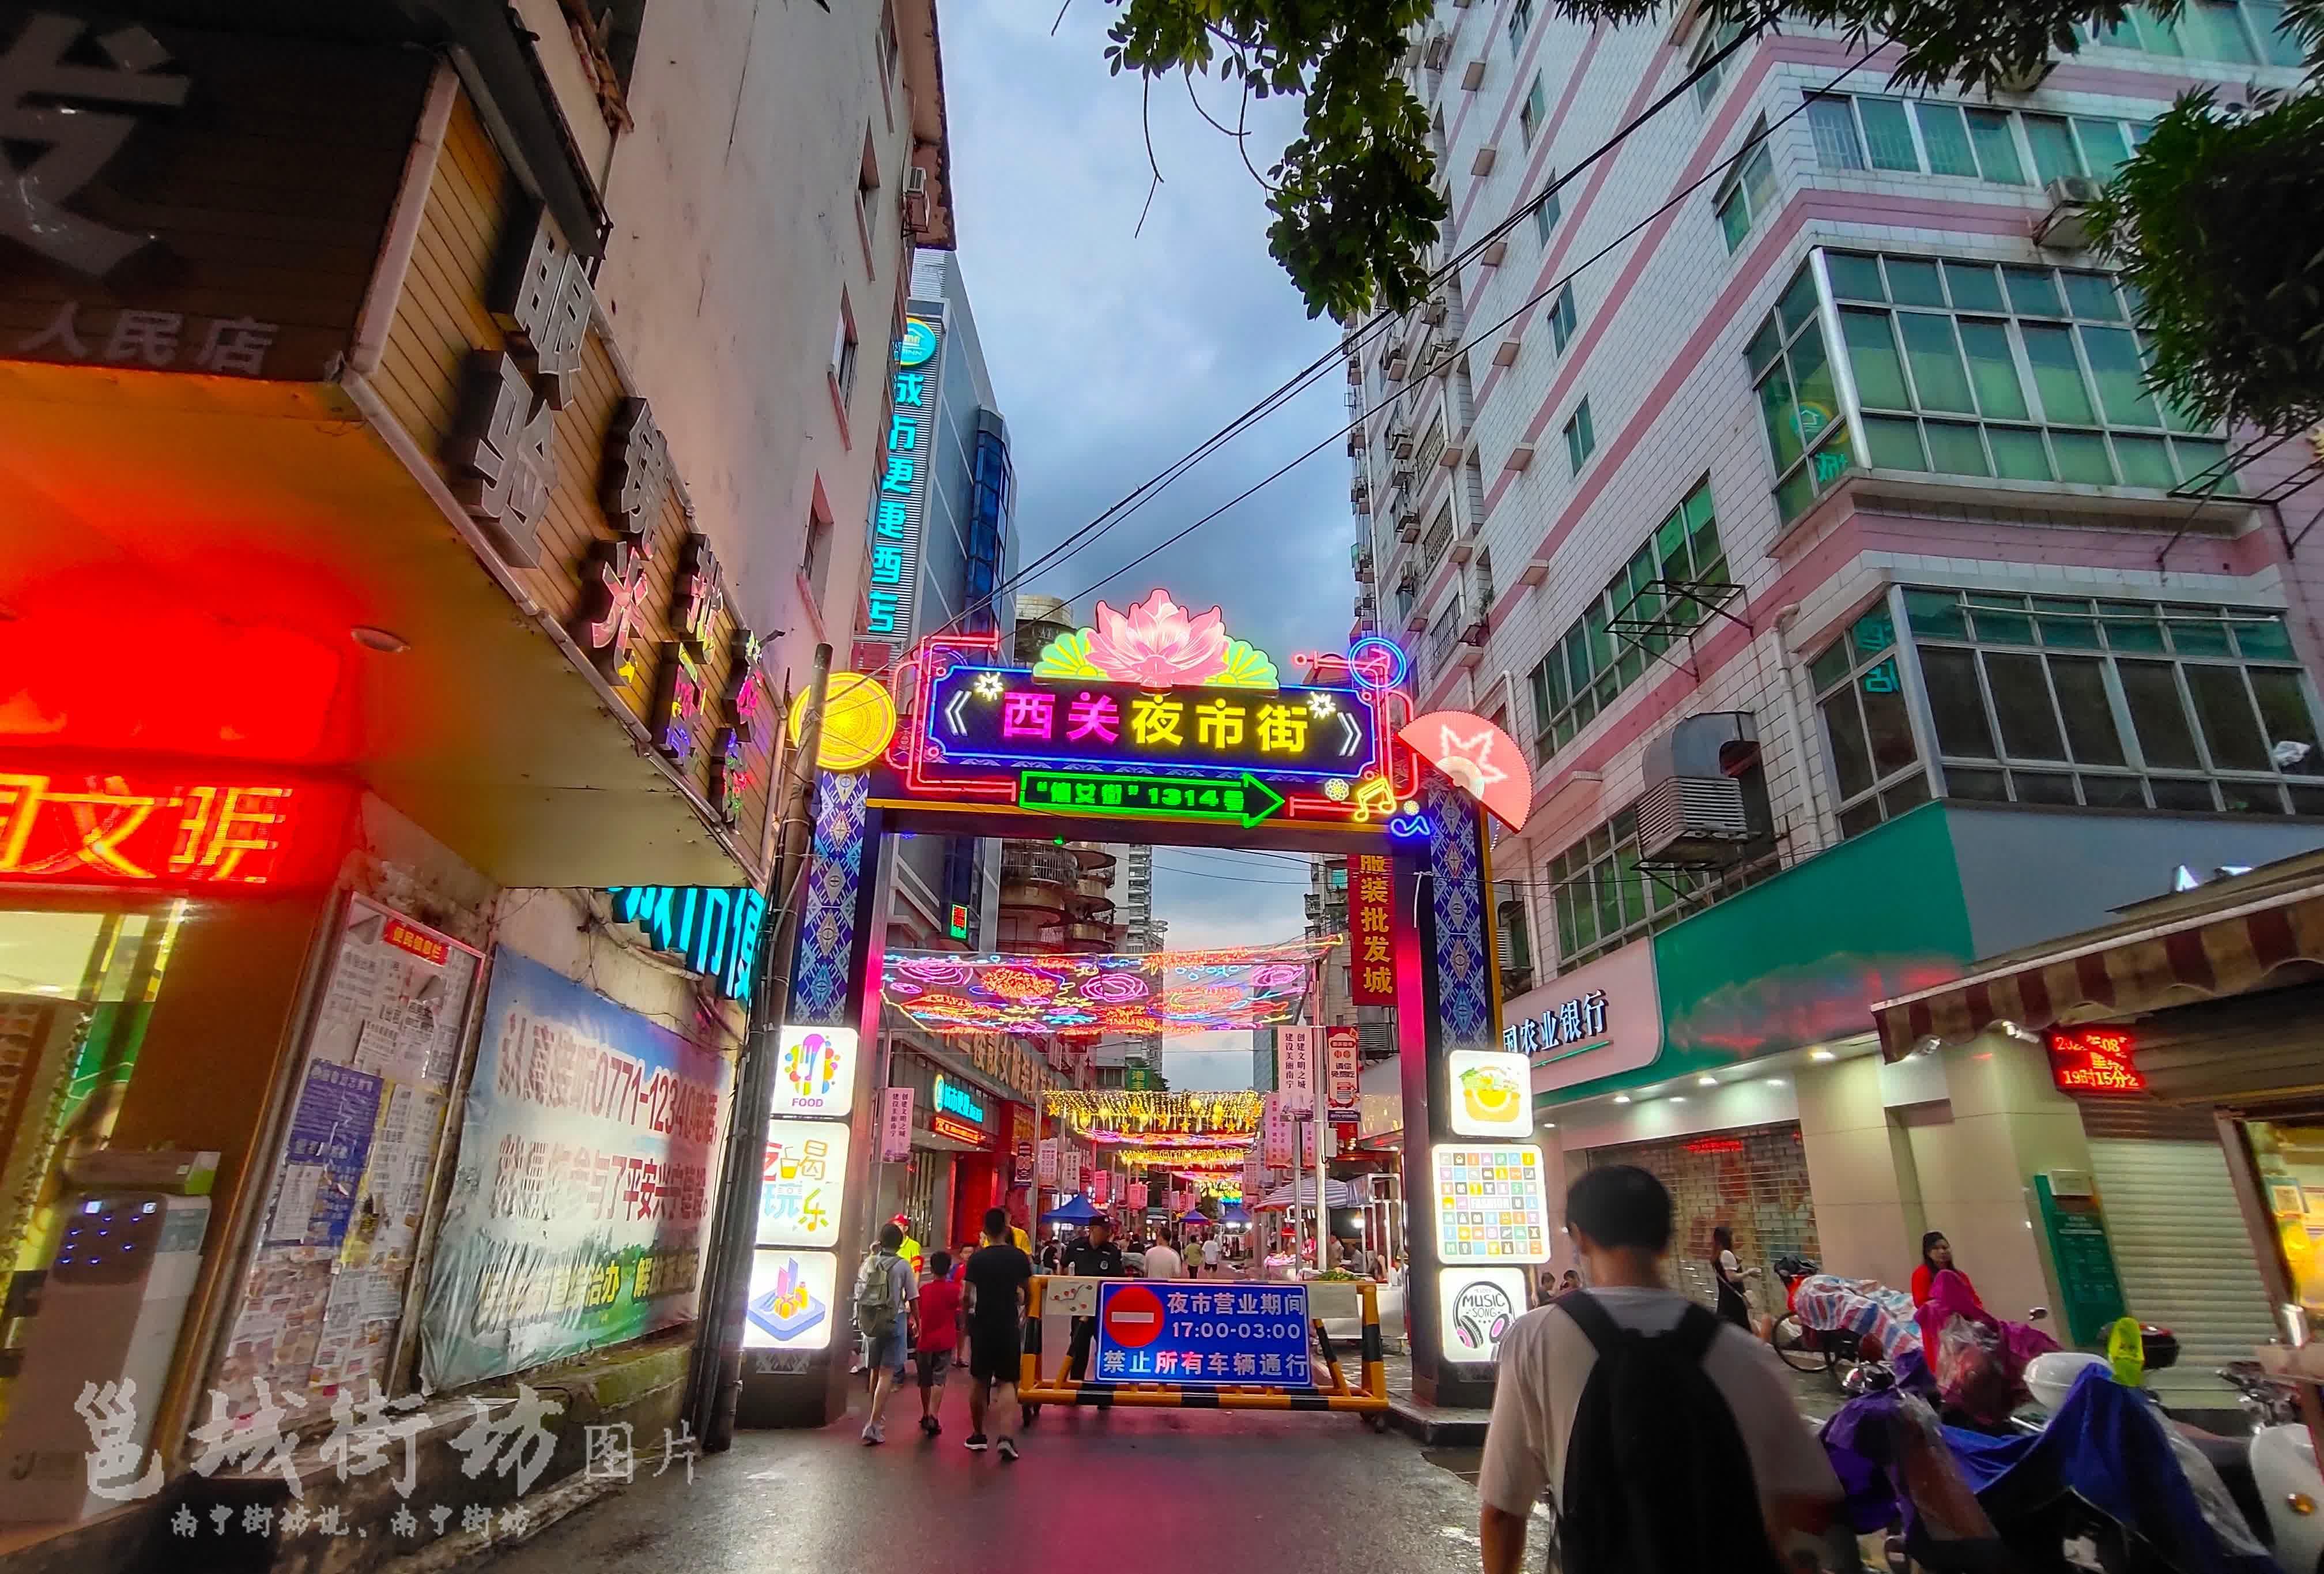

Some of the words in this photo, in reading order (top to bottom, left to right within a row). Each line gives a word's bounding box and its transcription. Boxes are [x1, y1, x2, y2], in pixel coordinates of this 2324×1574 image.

[18, 302, 280, 376] 人民店
[1360, 854, 1393, 994] 服装批发城
[1285, 1033, 1293, 1089] 建设美丽南宁
[1297, 1033, 1306, 1089] 创建文明之城
[791, 1098, 824, 1108] FOOD
[1168, 1292, 1304, 1316] 夜市营业期间
[1462, 1293, 1506, 1308] MUSIC
[1472, 1307, 1497, 1317] SONG
[1172, 1322, 1300, 1339] 17:00-03:00
[1103, 1350, 1308, 1377] 禁止所有车辆通行
